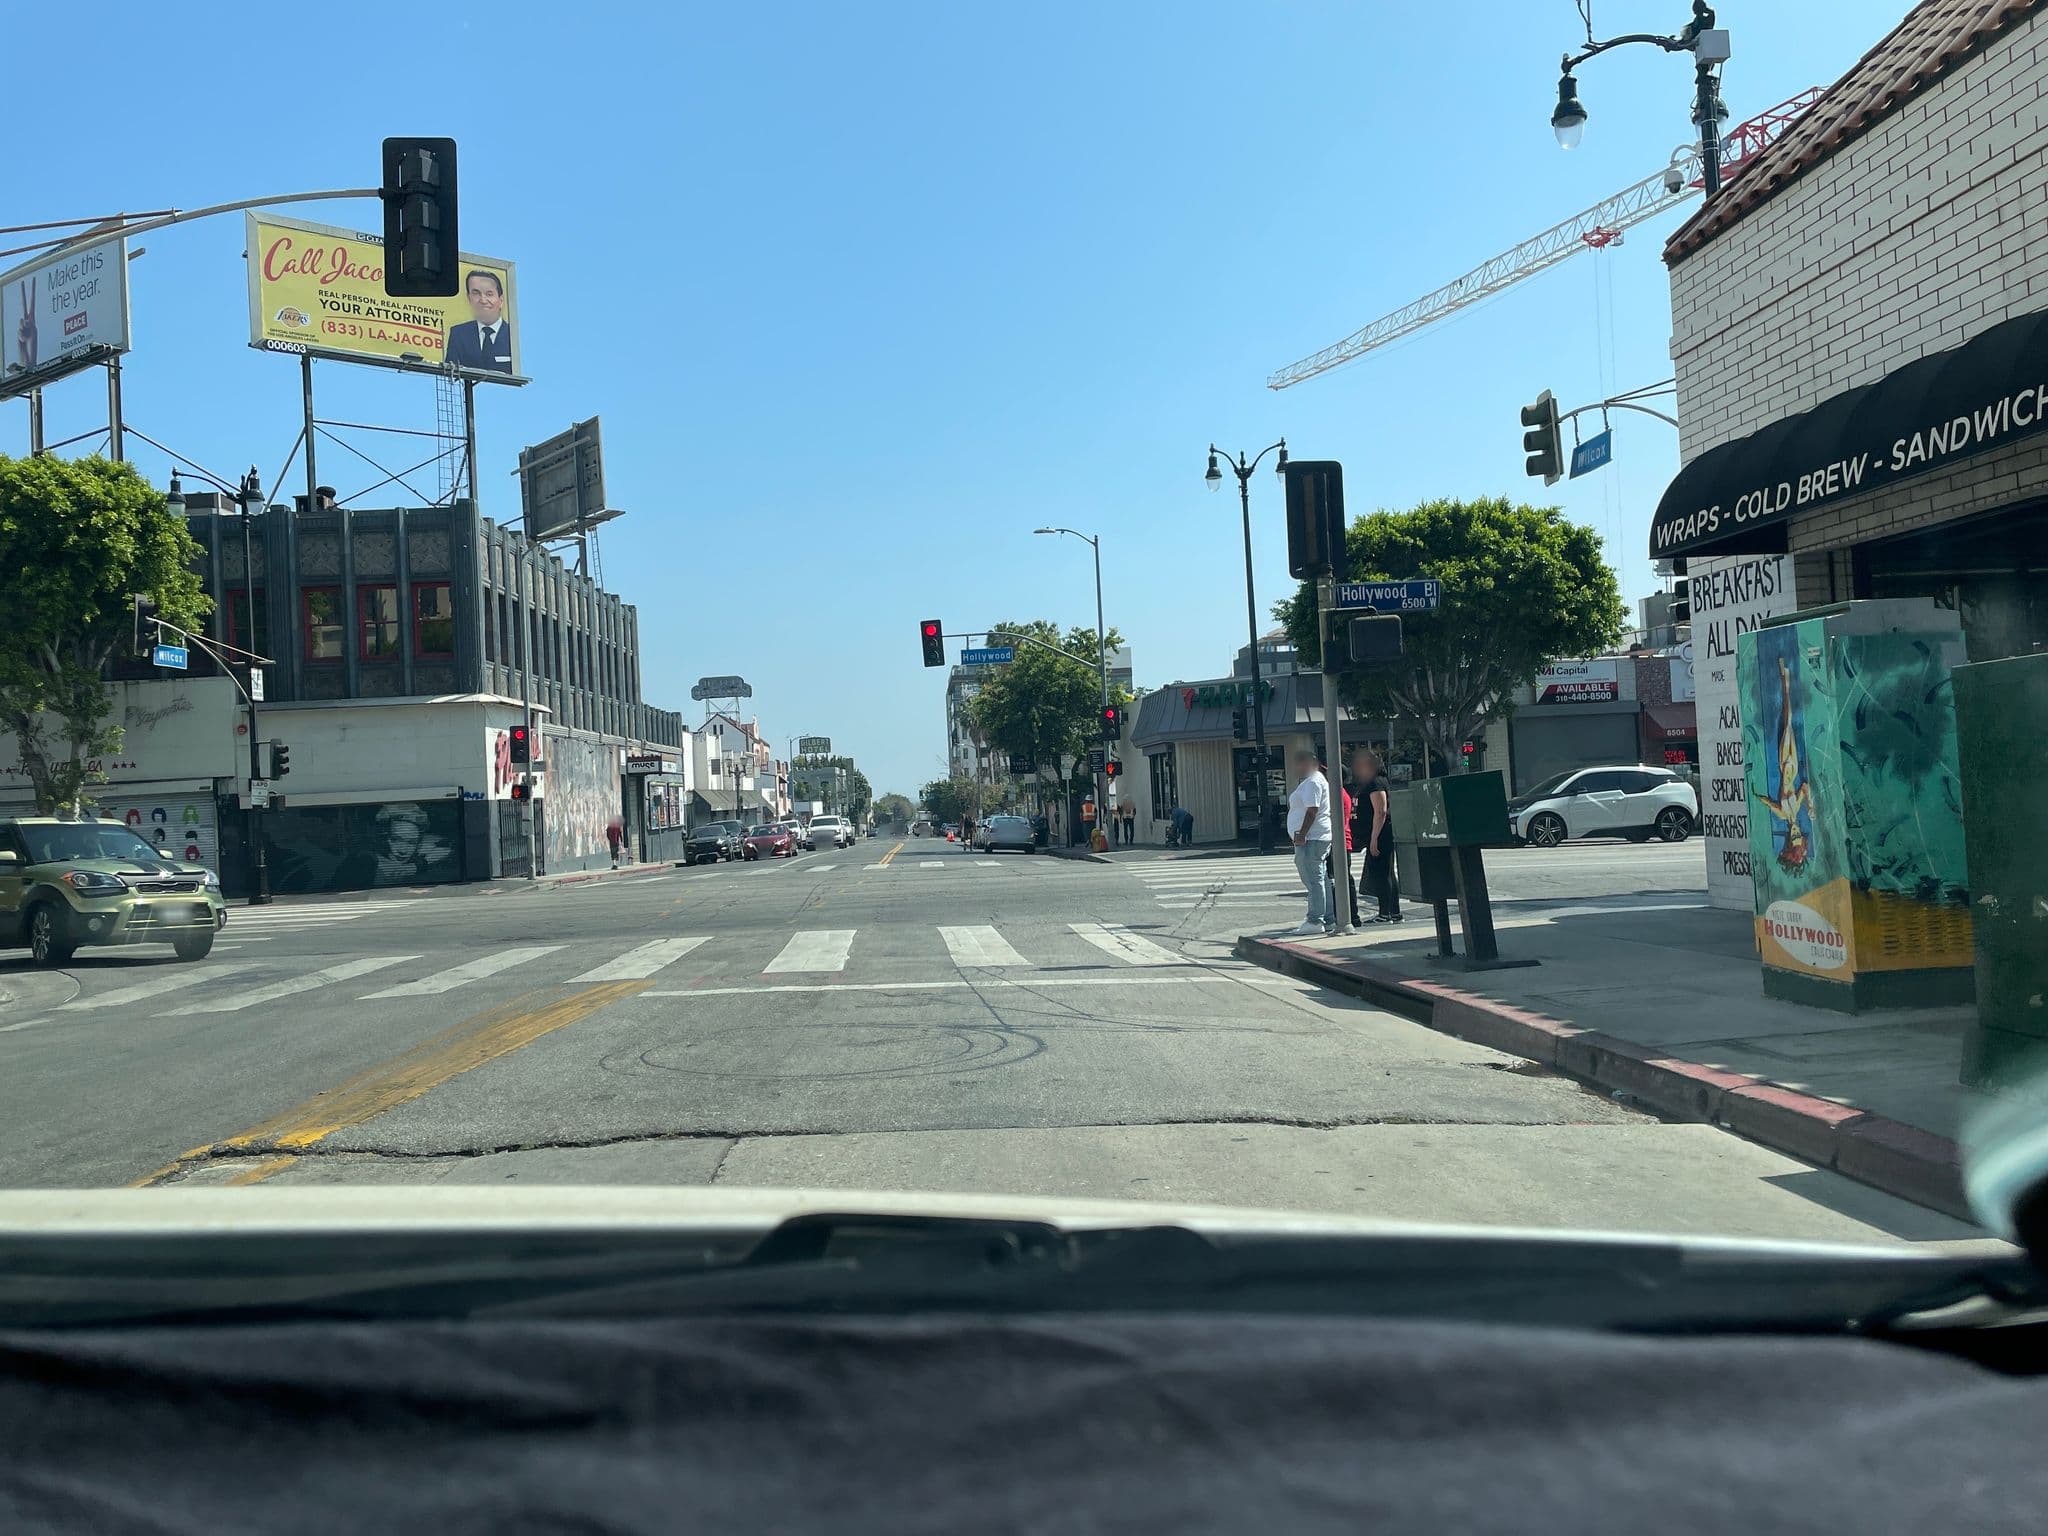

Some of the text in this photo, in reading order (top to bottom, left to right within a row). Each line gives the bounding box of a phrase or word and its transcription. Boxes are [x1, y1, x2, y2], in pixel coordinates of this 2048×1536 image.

[264, 237, 323, 281] Call
[48, 251, 104, 292] Make this
[51, 278, 101, 313] the year.
[319, 290, 445, 316] REAL PERSON, REAL ATTORNEY
[319, 298, 361, 315] YOUR
[65, 314, 87, 332] PEACE
[321, 320, 443, 349] (833) LA-JACOB
[267, 340, 306, 353] 000603
[1577, 443, 1607, 468] Wilcox
[1656, 505, 1720, 549] WRAPS
[1735, 482, 1791, 524] COLD
[1797, 452, 1869, 505] BREW
[1341, 582, 1436, 604] Hollywood Bl
[1693, 555, 1784, 613] BREAKFAST
[1401, 597, 1437, 609] 6500 W
[1707, 620, 1735, 659] ALL
[159, 650, 183, 663] Wilcox
[962, 652, 1011, 662] Hollywood
[1556, 666, 1588, 677] Capital
[1555, 692, 1612, 702] 310-440-8500
[1556, 683, 1611, 694] AVAILABLE
[1719, 705, 1739, 729] ACAI
[800, 738, 830, 746] GILBERT
[1705, 814, 1748, 839] BREAKFAST
[1764, 918, 1844, 948] HOLLYWOOD
